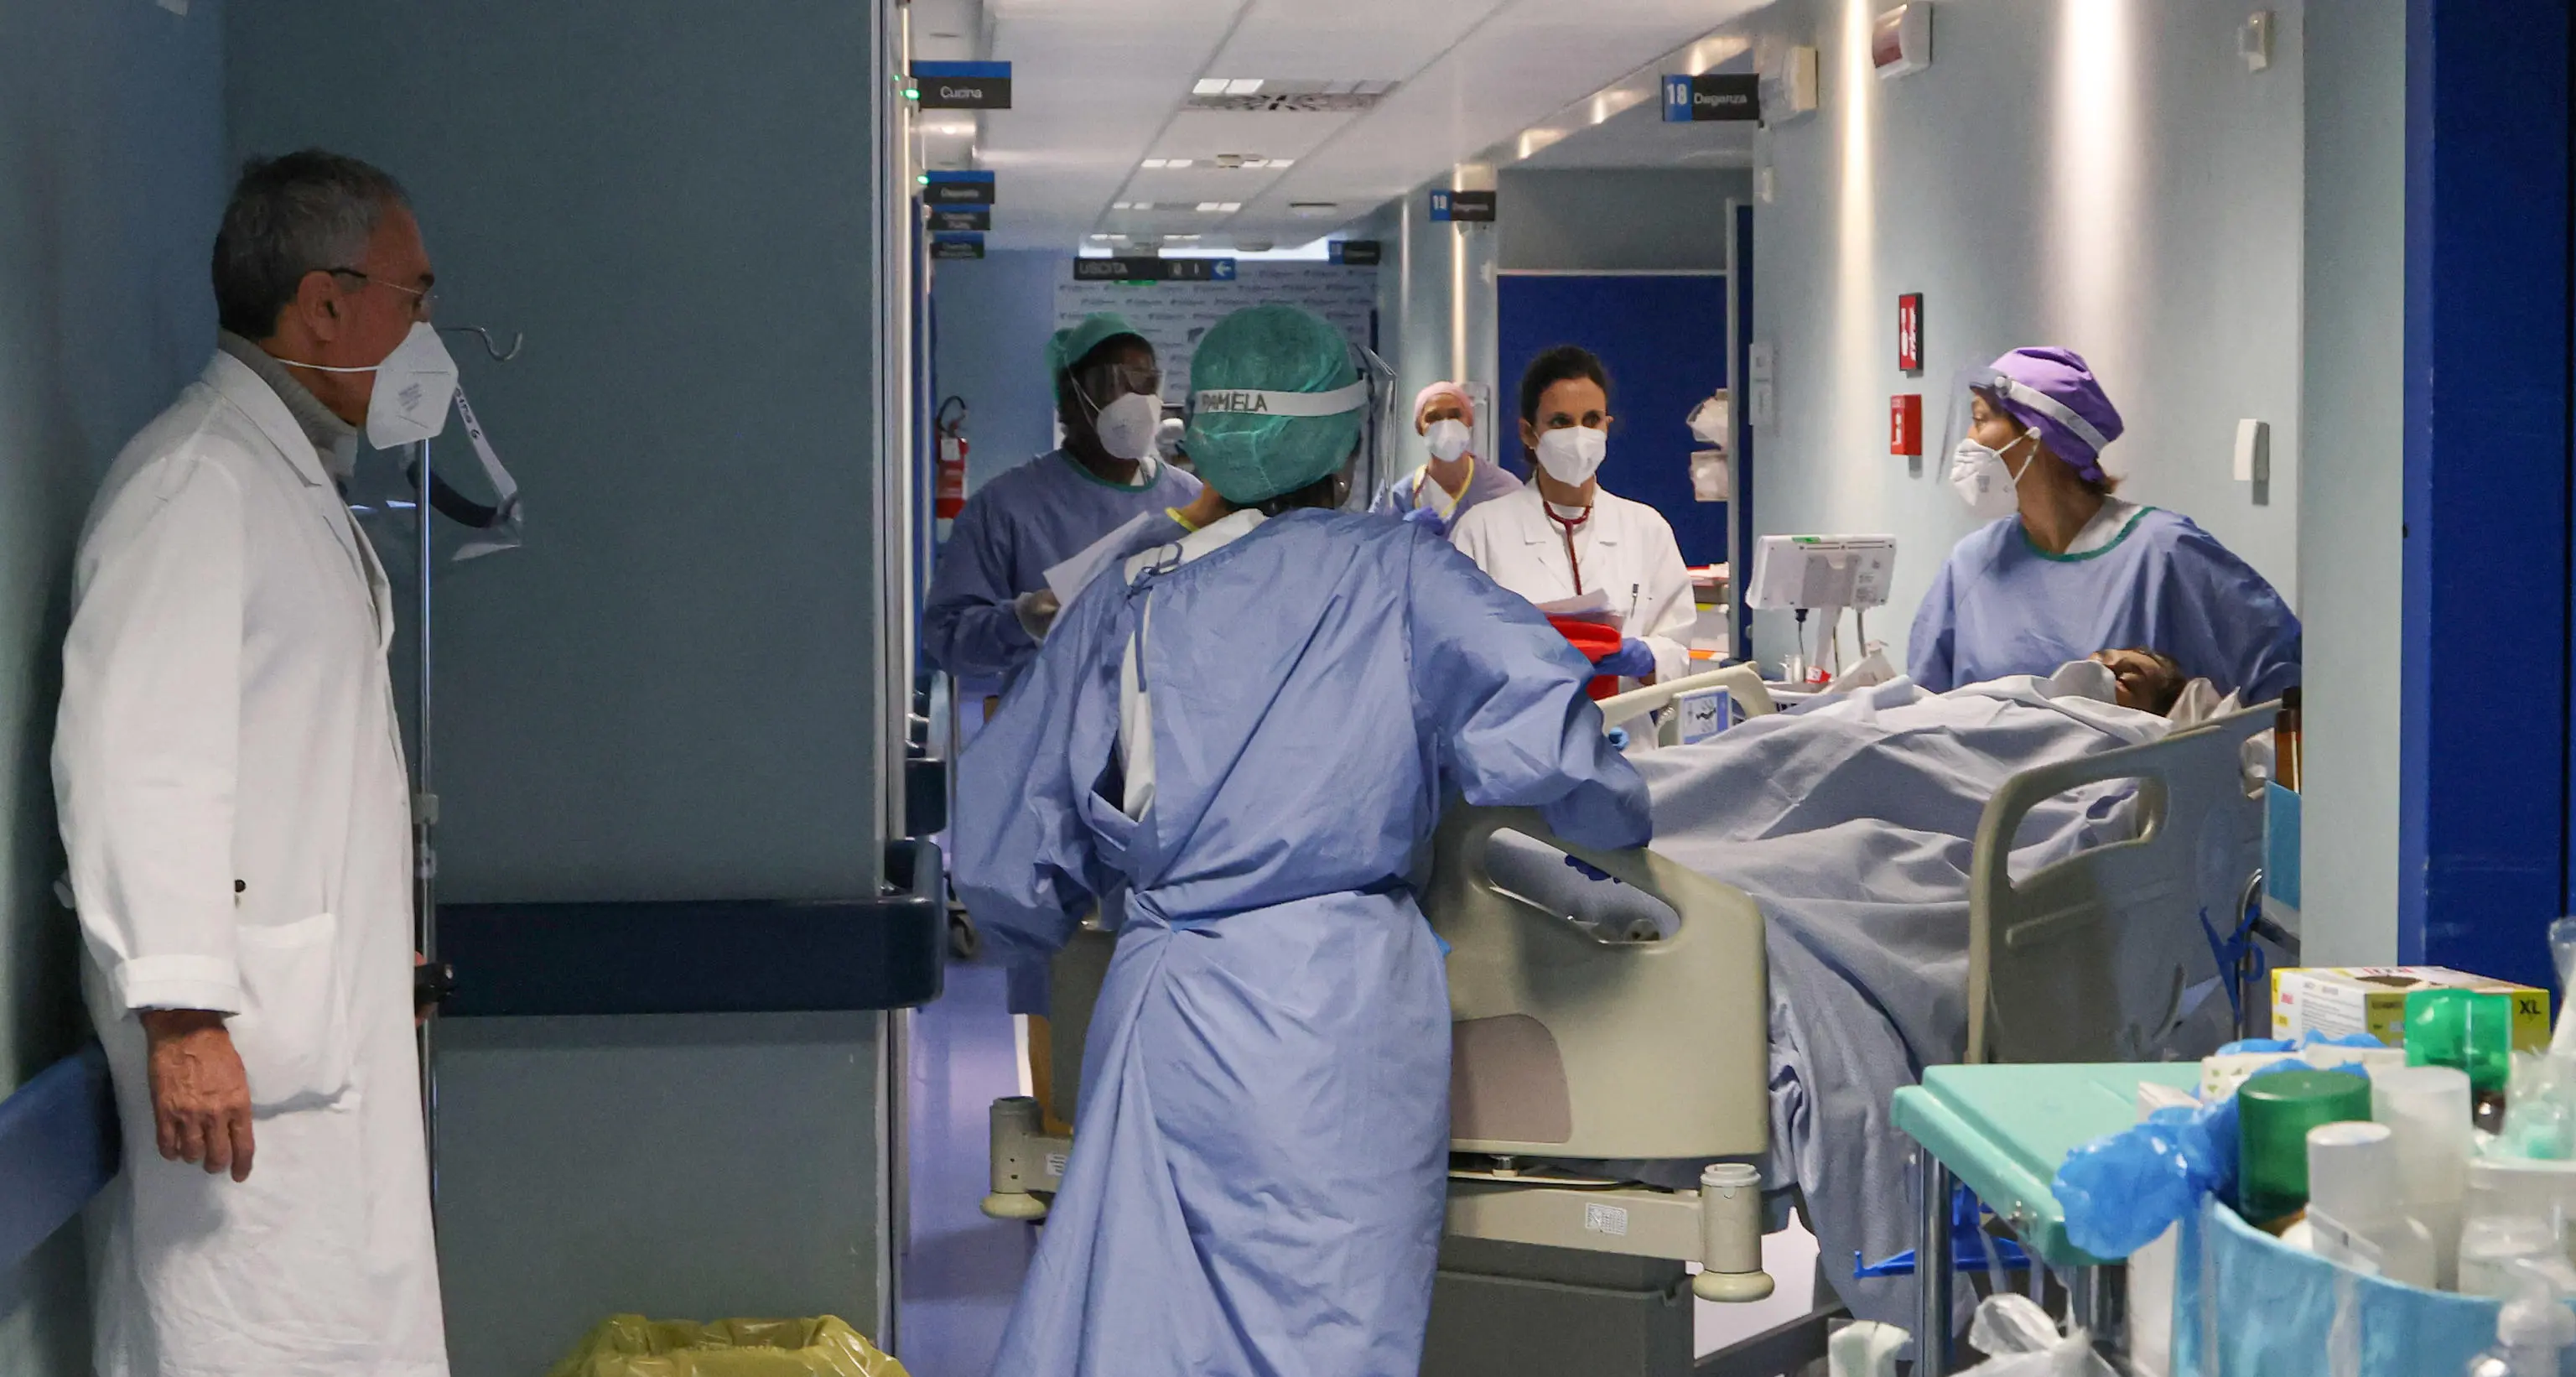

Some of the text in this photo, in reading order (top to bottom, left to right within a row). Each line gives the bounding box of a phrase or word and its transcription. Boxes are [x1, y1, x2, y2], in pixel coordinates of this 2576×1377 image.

[940, 86, 983, 99] Cucina
[1079, 262, 1129, 274] USCITA
[1202, 392, 1267, 412] PAMELA
[2519, 999, 2542, 1015] XL
